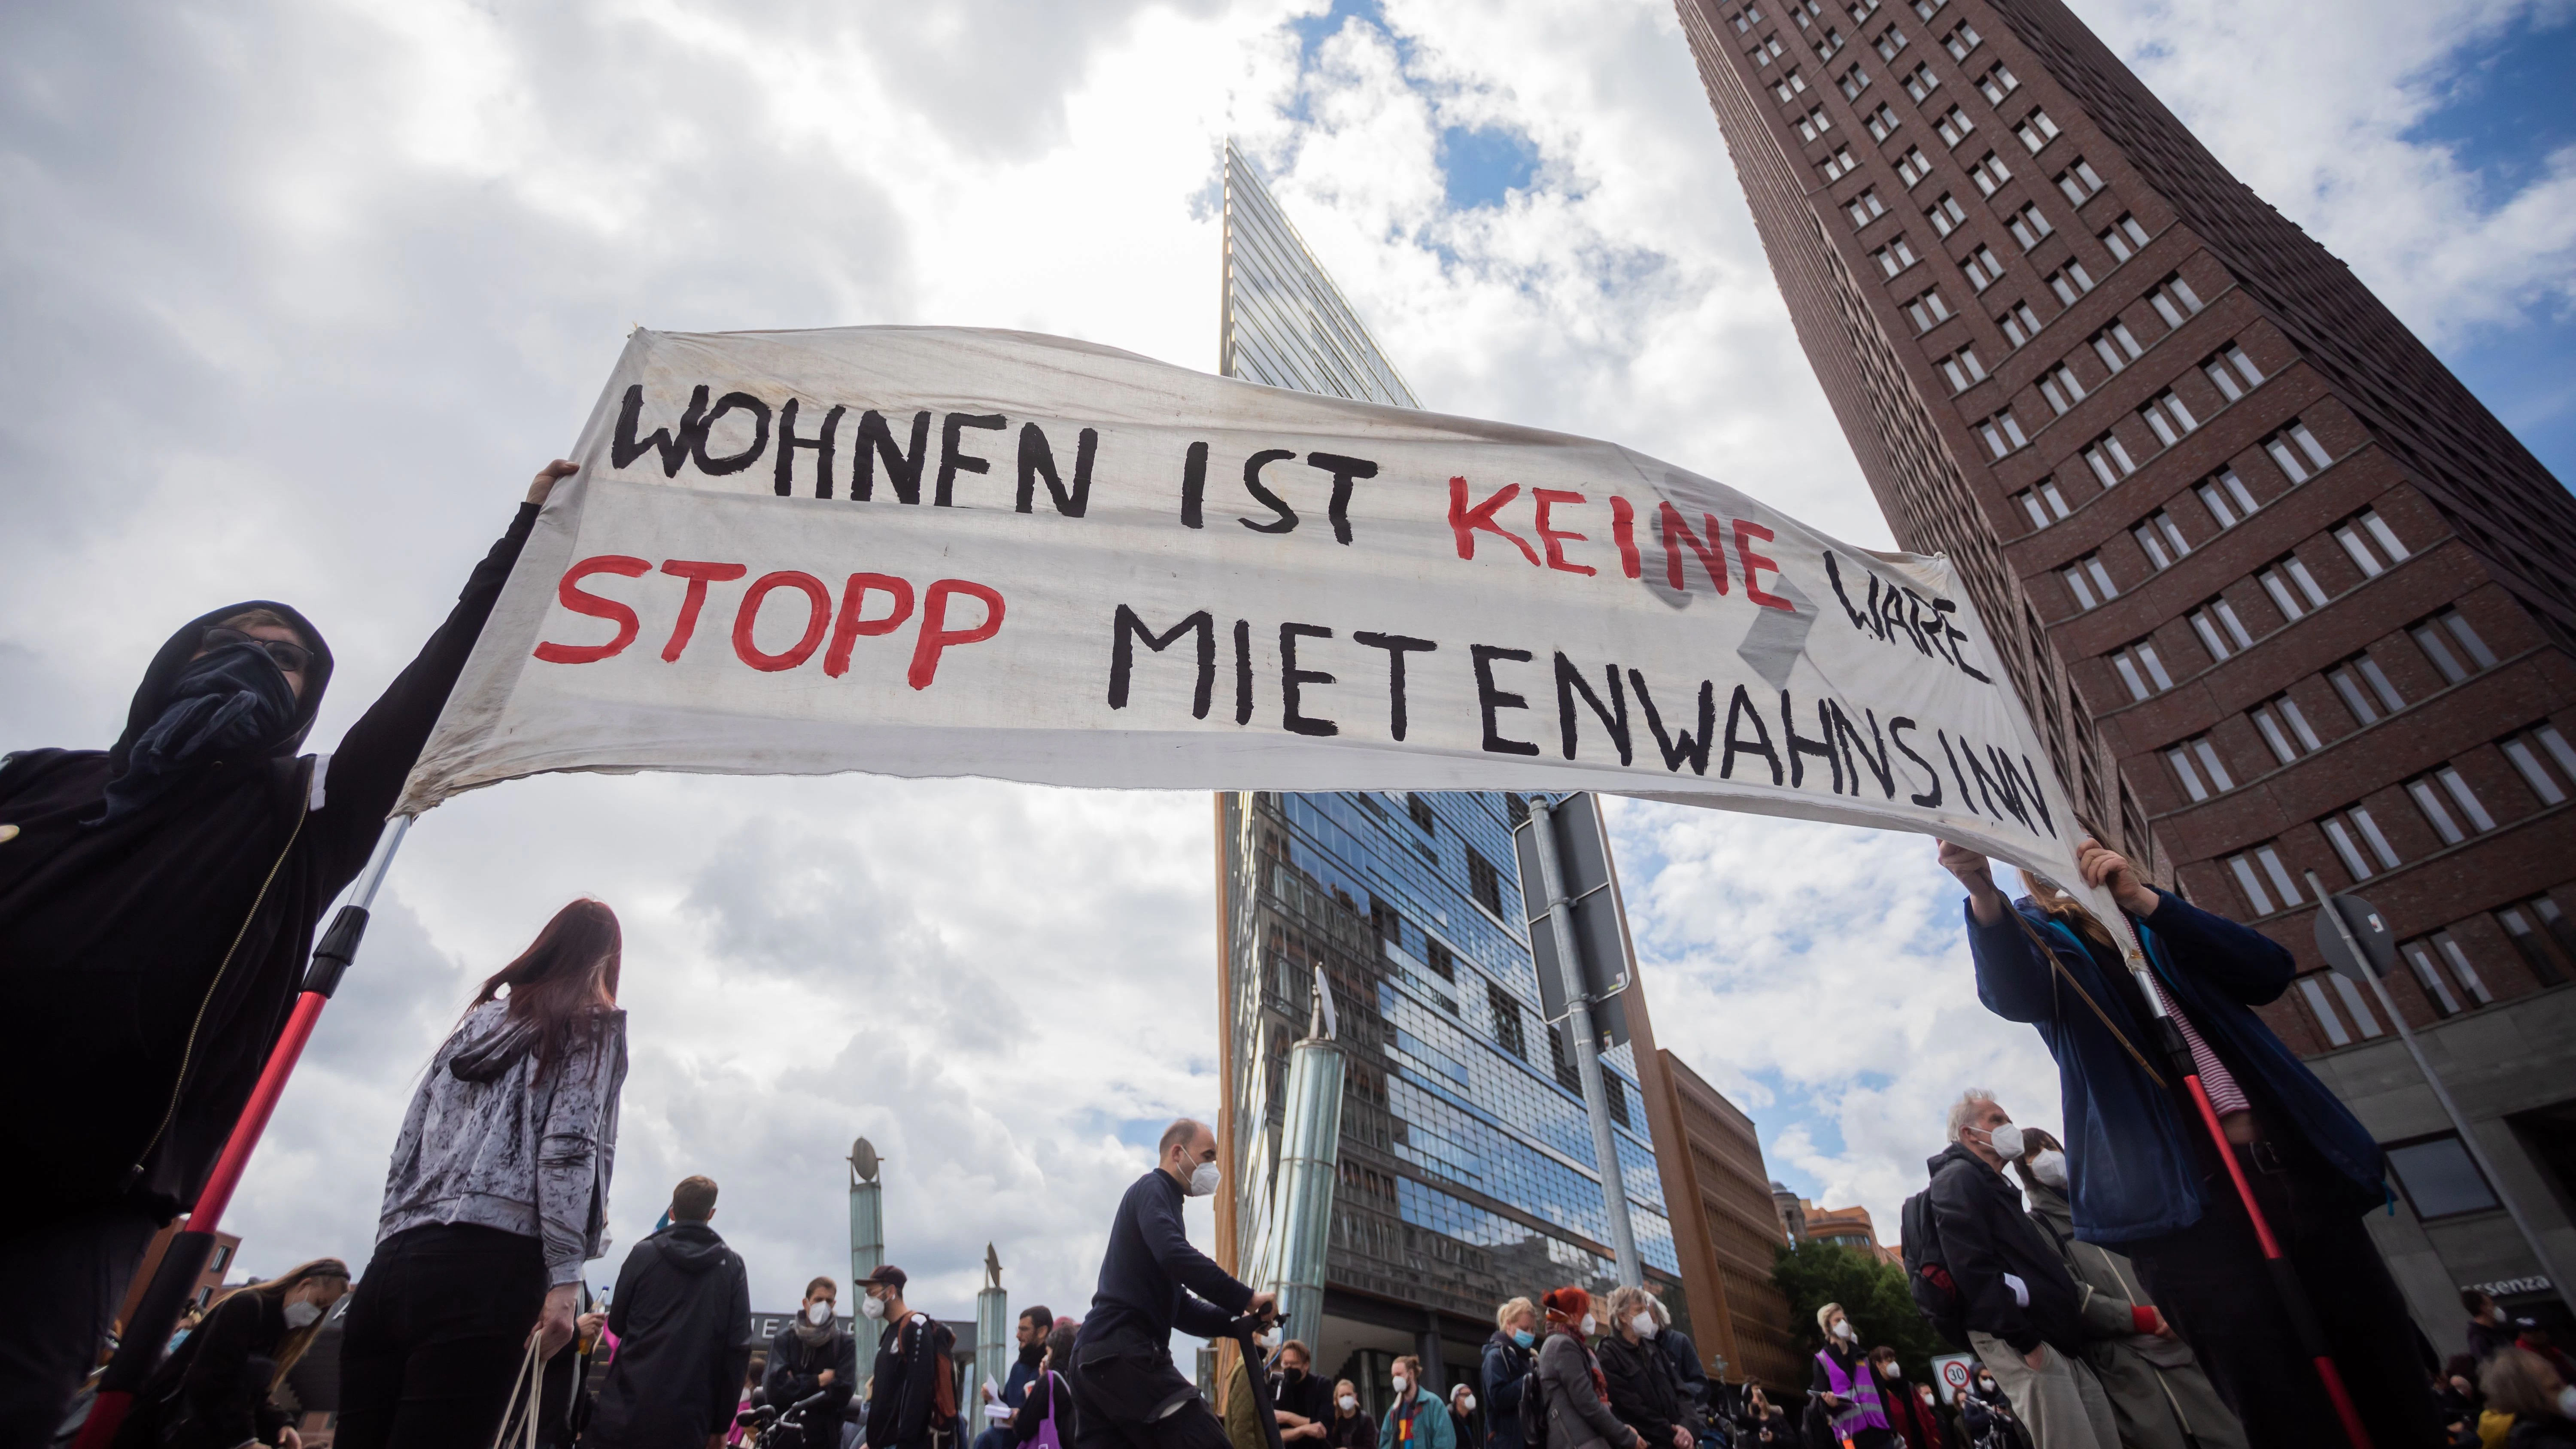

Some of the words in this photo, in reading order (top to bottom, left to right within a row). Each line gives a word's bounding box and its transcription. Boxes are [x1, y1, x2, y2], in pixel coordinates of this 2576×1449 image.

[1180, 441, 1379, 547] IST
[1448, 476, 1795, 611] KEINE
[1823, 550, 1992, 685] WARE
[533, 555, 1005, 691] STOPP
[1107, 603, 2056, 838] MIETENWAHNSINN
[1948, 1367, 1964, 1381] 30
